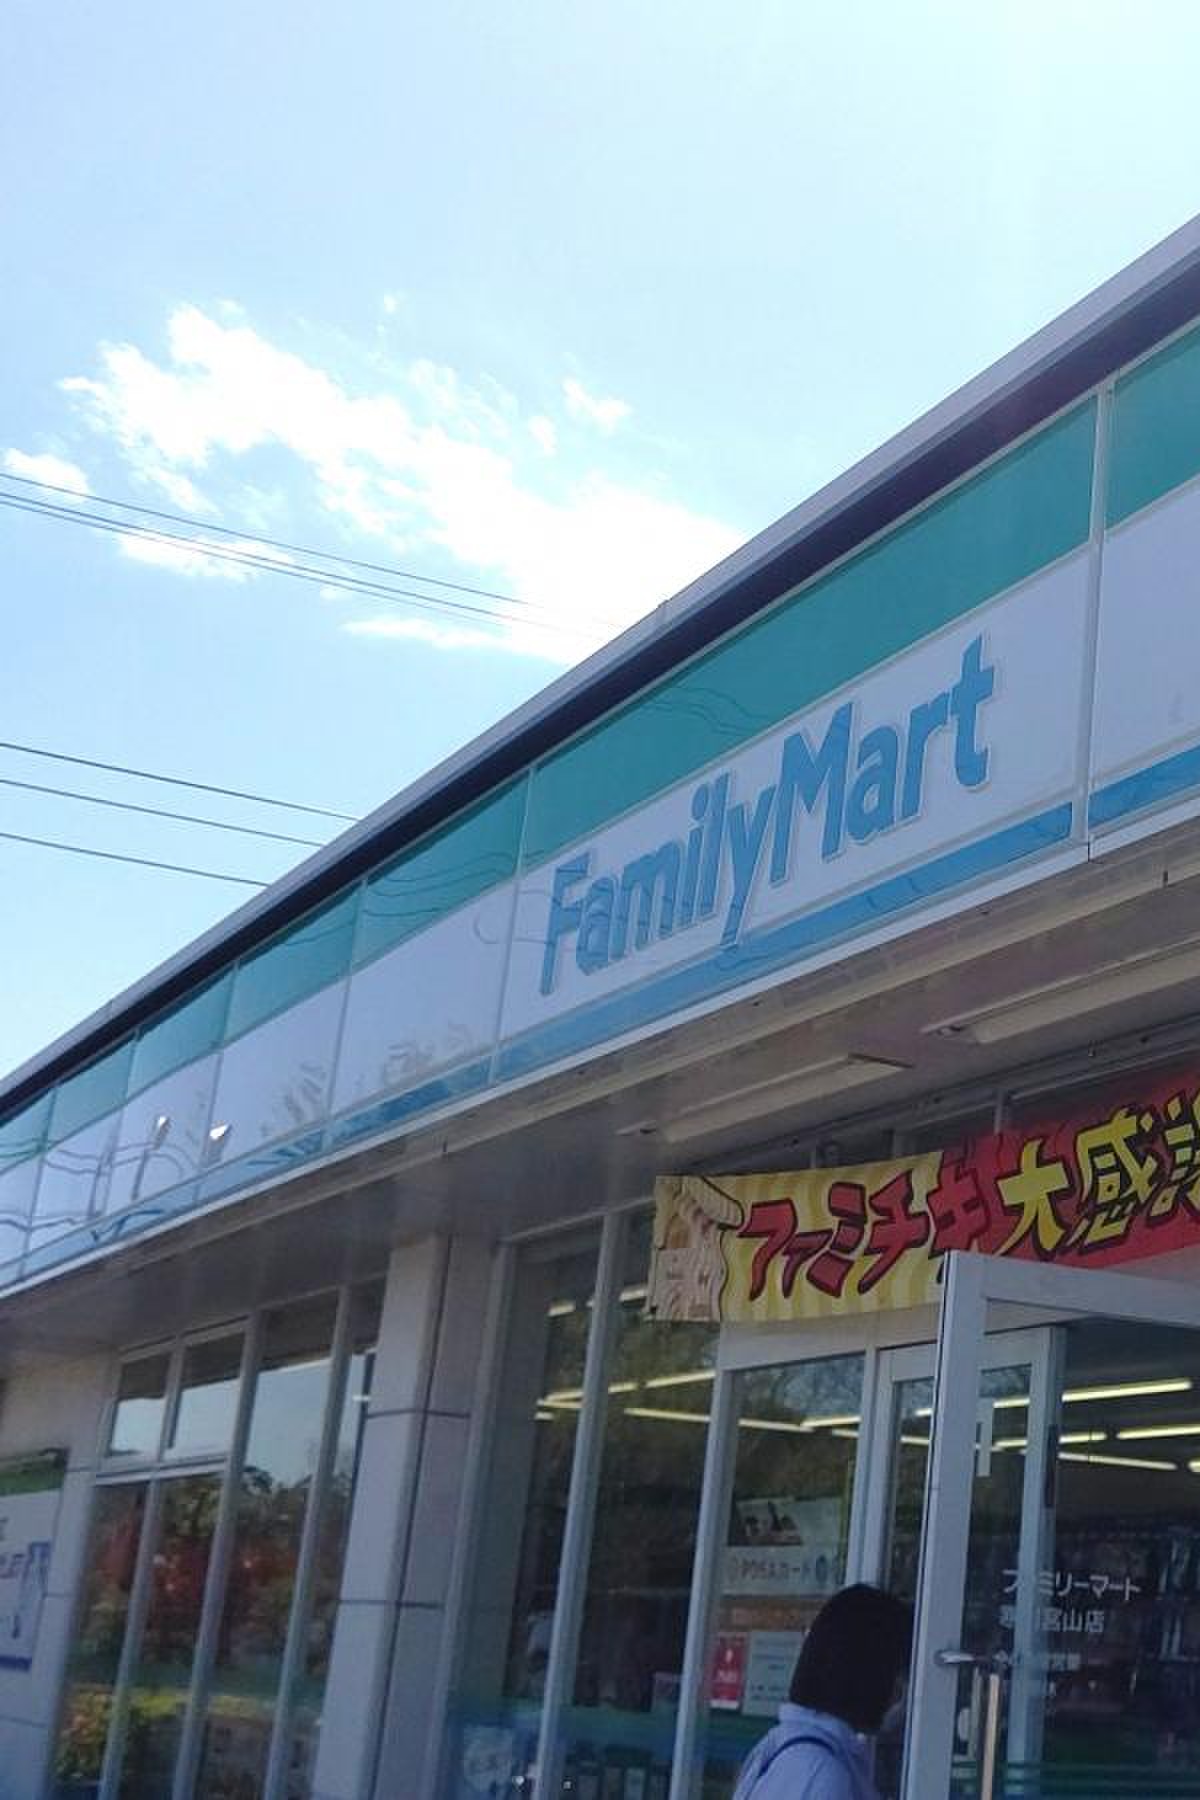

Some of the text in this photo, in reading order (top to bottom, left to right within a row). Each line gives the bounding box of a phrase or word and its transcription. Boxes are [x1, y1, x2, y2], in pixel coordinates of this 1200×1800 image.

[541, 635, 996, 997] FamilyMart
[1002, 1570, 1141, 1601] フミリーマート
[999, 1604, 1105, 1633] 宮山店
